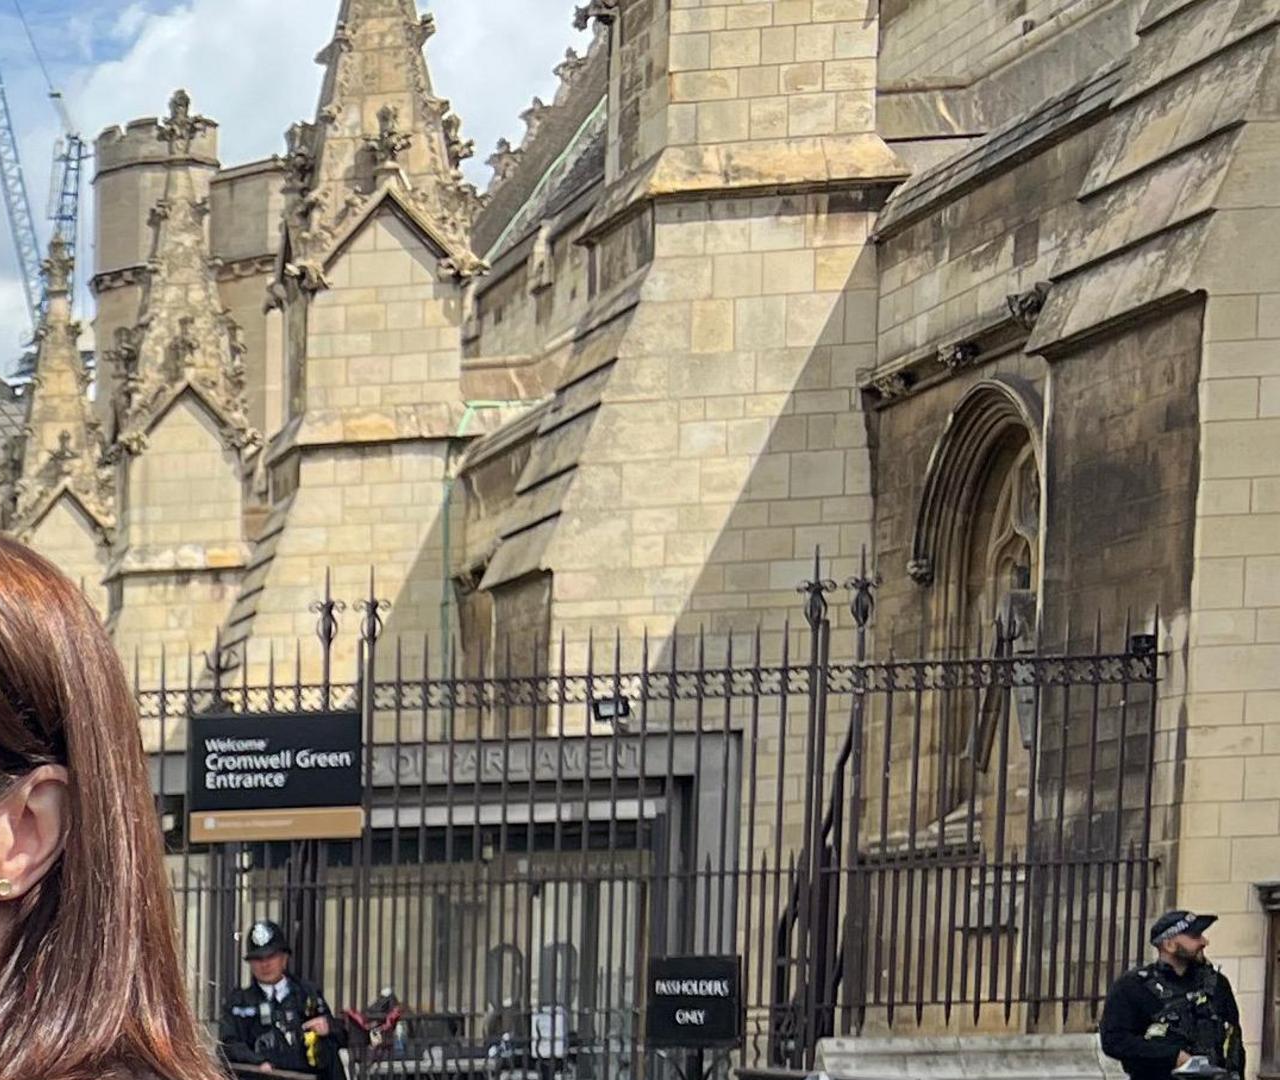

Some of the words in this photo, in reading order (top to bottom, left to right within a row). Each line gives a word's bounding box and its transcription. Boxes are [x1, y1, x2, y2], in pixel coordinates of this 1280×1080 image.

[205, 738, 267, 752] Welcome
[205, 751, 291, 770] Cromwell
[296, 751, 352, 769] Green
[205, 771, 287, 789] Entrance
[654, 979, 730, 996] PASSHOLDERS
[675, 1009, 705, 1025] ONLY
